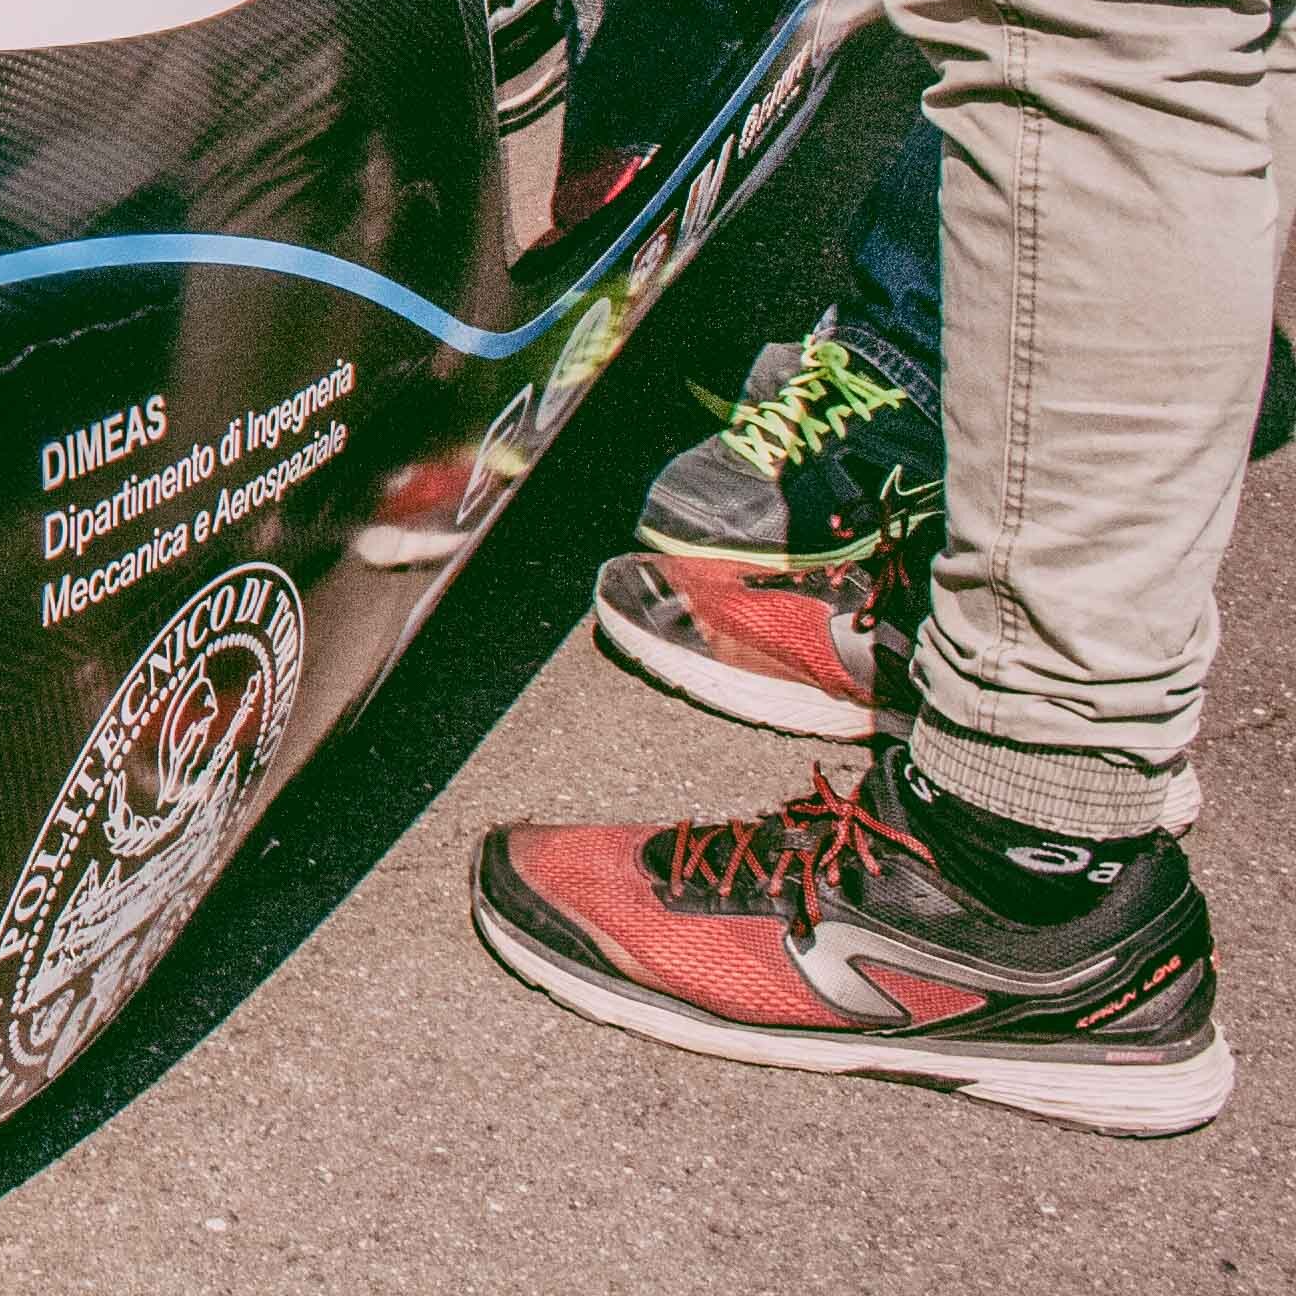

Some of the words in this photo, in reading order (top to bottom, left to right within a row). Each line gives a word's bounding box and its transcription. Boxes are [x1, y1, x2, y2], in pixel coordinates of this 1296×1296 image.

[40, 394, 168, 492] DIMEAS
[42, 444, 216, 560] Dipartimento
[219, 418, 242, 467] di
[246, 358, 356, 453] Ingegneria
[40, 520, 189, 628] Meccanica
[193, 509, 210, 544] e
[211, 420, 350, 535] Aerospaziale
[234, 577, 274, 625] DI
